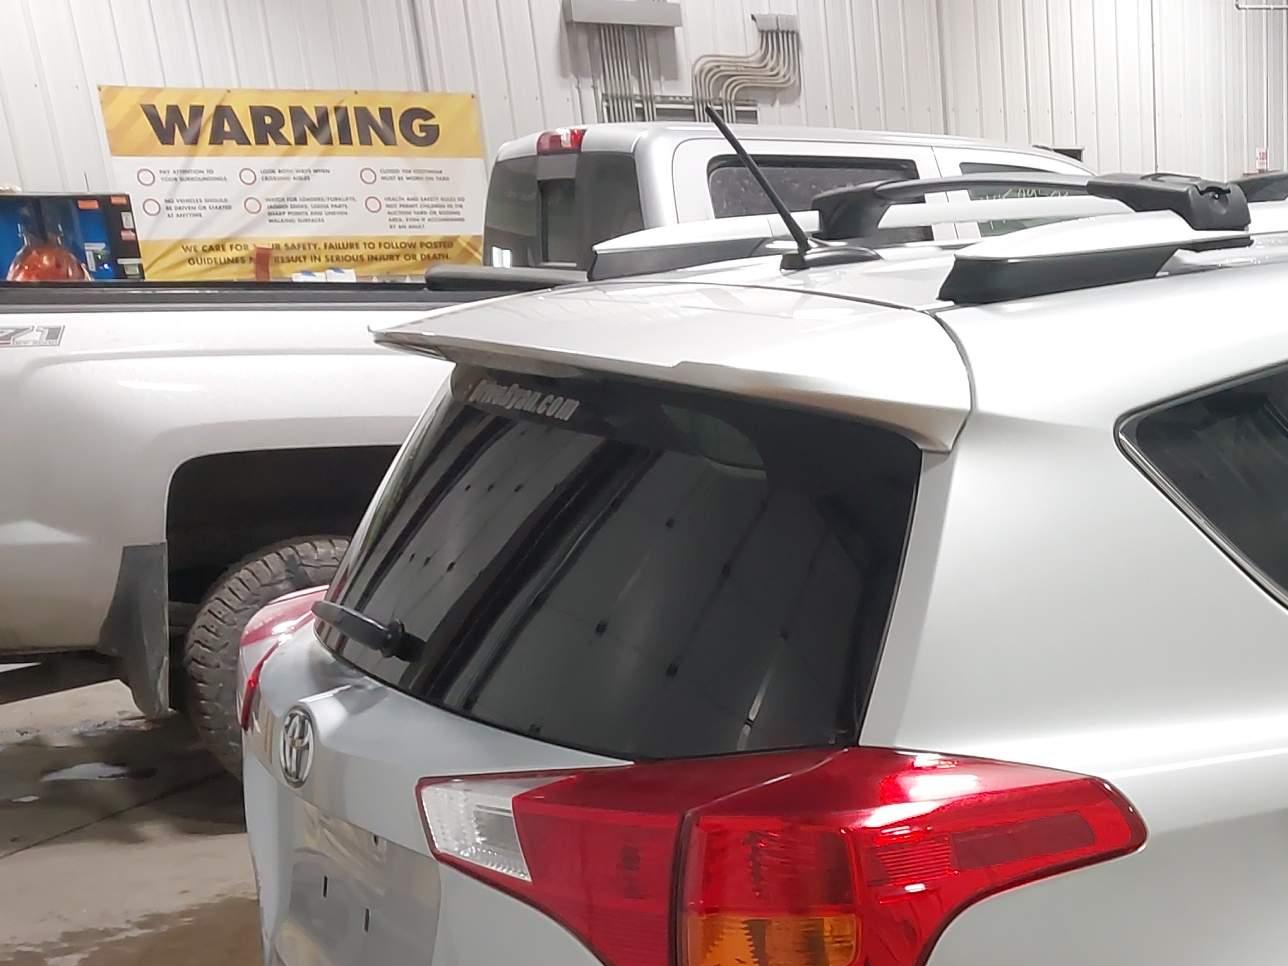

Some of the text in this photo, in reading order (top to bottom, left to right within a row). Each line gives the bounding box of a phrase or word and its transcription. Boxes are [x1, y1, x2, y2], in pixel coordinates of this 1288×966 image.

[140, 104, 440, 147] WARNING
[182, 244, 198, 254] WE
[202, 243, 225, 253] CARE
[230, 243, 249, 252] FOR
[324, 241, 360, 250] FAILURE
[363, 241, 376, 249] TO
[378, 240, 416, 249] FOLLOW
[420, 240, 454, 249] POSTED
[188, 255, 246, 266] GUIDELINES
[274, 255, 308, 264] RESULT
[310, 254, 321, 263] IN
[324, 253, 364, 263] SERIOUS
[367, 252, 400, 262] INJURY
[403, 252, 417, 261] OR
[420, 252, 451, 262] DEATH.
